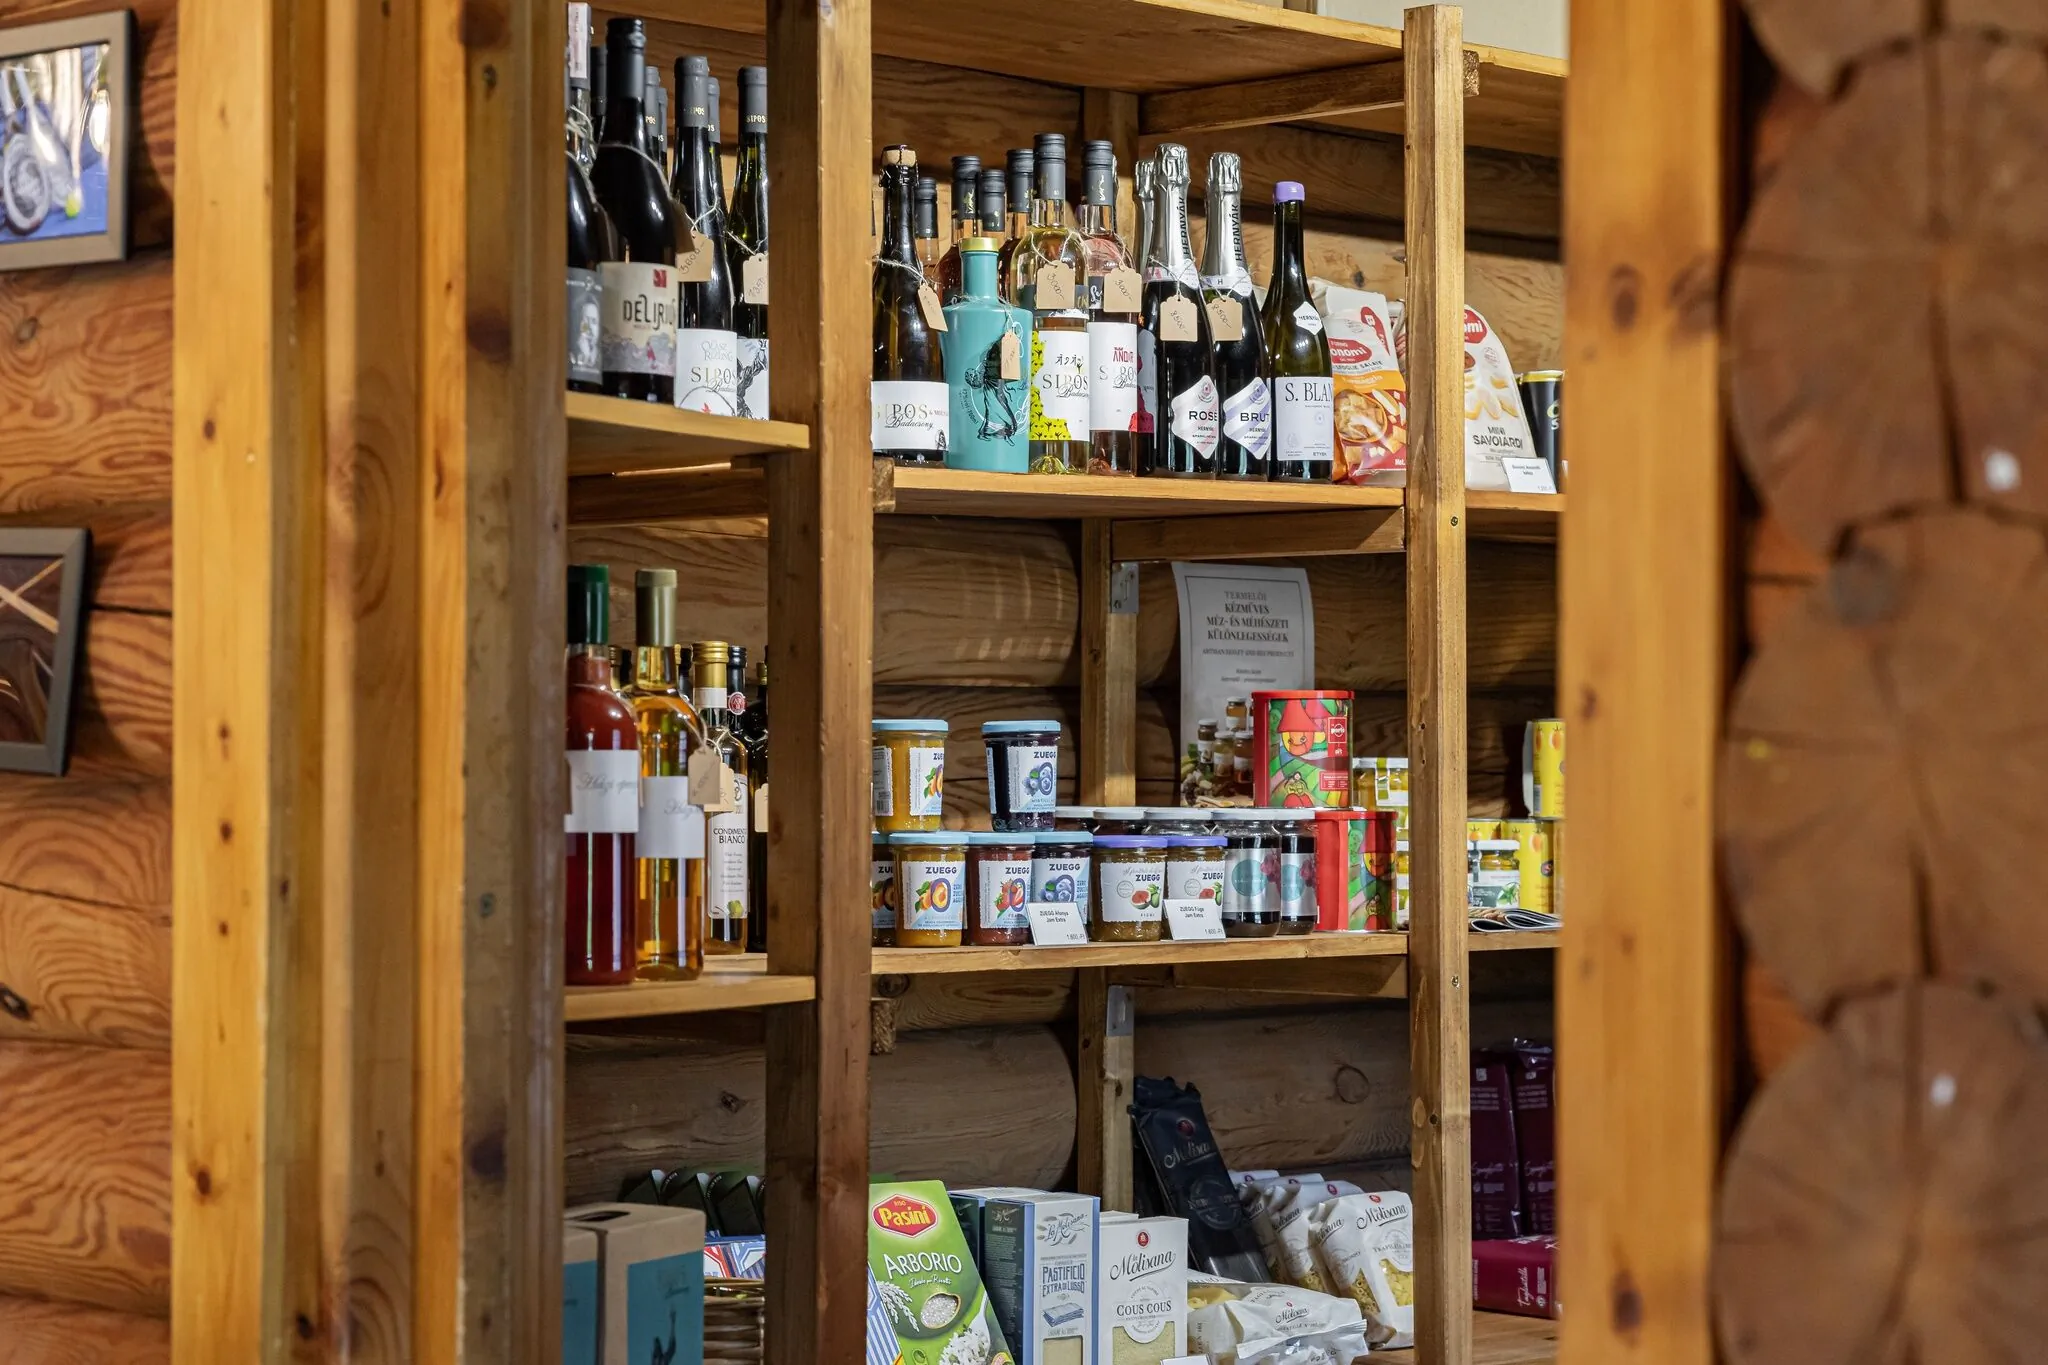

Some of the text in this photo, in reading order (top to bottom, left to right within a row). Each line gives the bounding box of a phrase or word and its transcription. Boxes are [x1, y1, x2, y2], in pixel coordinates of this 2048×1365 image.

[1177, 197, 1190, 255] HERNYÁK
[1229, 204, 1243, 261] HERNYÁK
[1329, 347, 1367, 357] onomi
[1285, 383, 1298, 402] S.
[1240, 413, 1269, 422] BRUT
[1473, 435, 1523, 450] SAVOIARDI
[1225, 601, 1270, 614] KÉZMŰVES
[1230, 615, 1241, 627] ÉS
[1241, 616, 1289, 629] MÉHÉSZETI
[1207, 628, 1289, 643] KÜLÖNLEGESSÉGEK
[719, 835, 745, 844] BIANCO
[925, 866, 957, 874] ZUEGG
[1005, 867, 1030, 875] ZUEGG
[1135, 874, 1161, 882] ZUEGG
[878, 1205, 931, 1227] Pasini
[1356, 1204, 1408, 1230] Molisana
[883, 1252, 962, 1279] ARBORIO
[1110, 1250, 1176, 1281] Molisana
[1042, 1263, 1085, 1284] PASTIFICIO
[1042, 1282, 1061, 1298] EXTRA
[1067, 1280, 1085, 1294] LUSSO
[1117, 1300, 1172, 1316] COUS COUS
